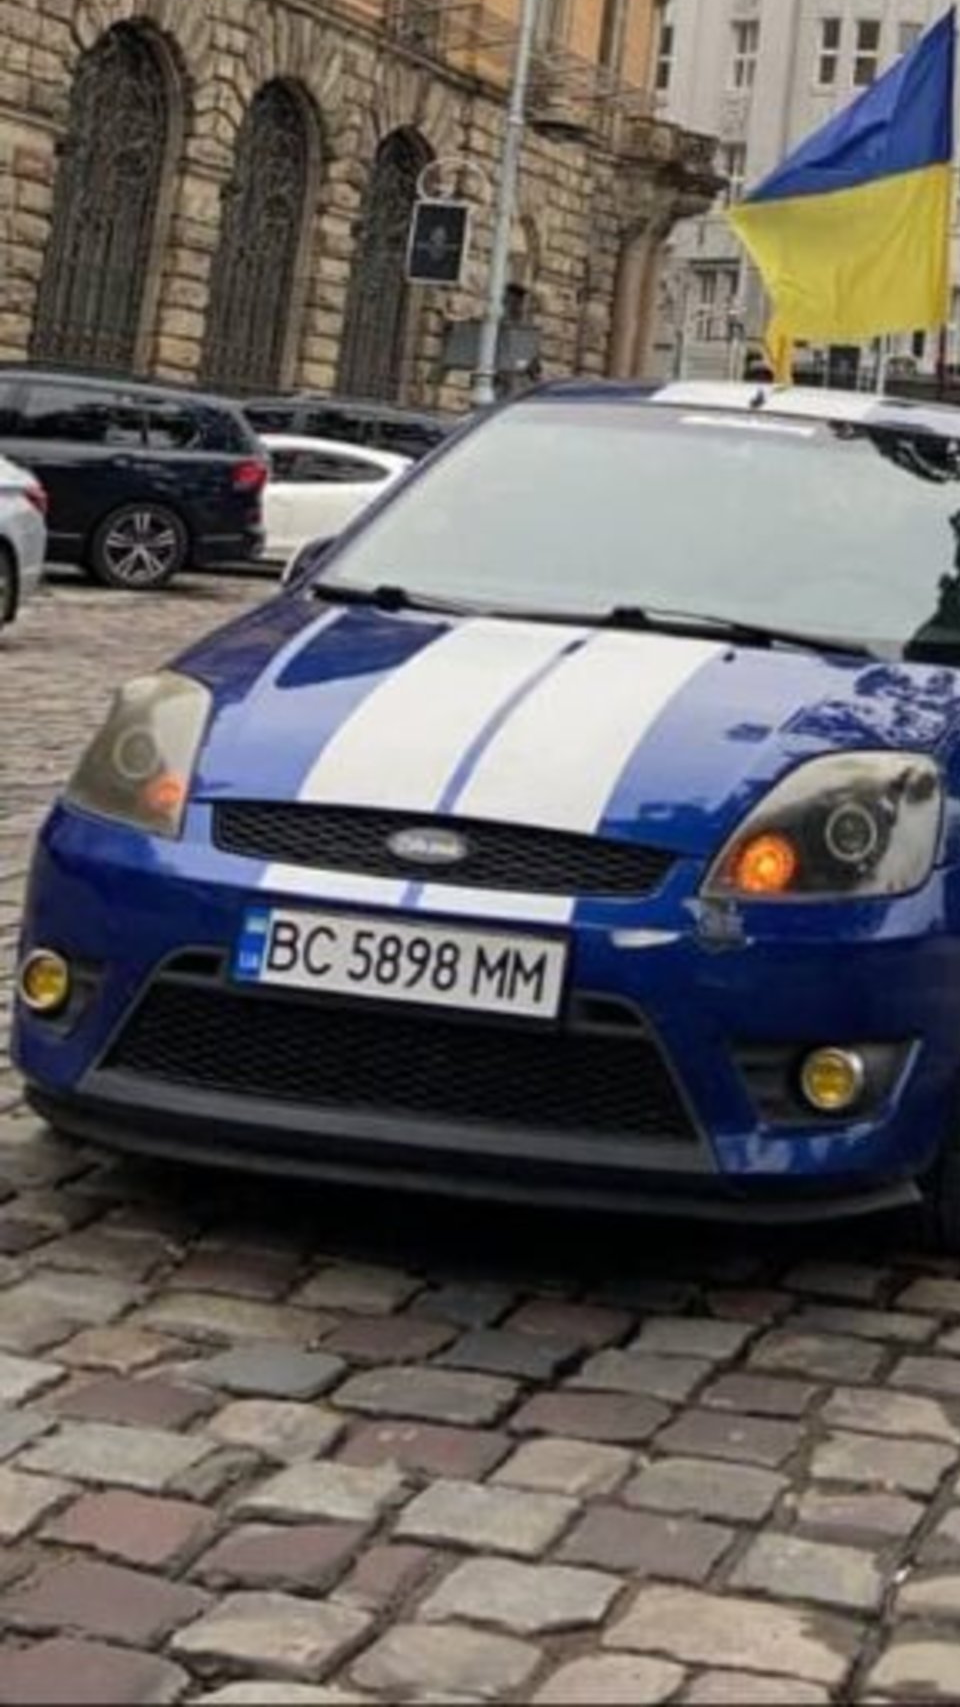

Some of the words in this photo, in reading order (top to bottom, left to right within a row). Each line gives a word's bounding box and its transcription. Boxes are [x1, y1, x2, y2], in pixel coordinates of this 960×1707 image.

[267, 921, 336, 976] BC
[347, 931, 461, 991] 5898
[470, 945, 548, 1003] MM
